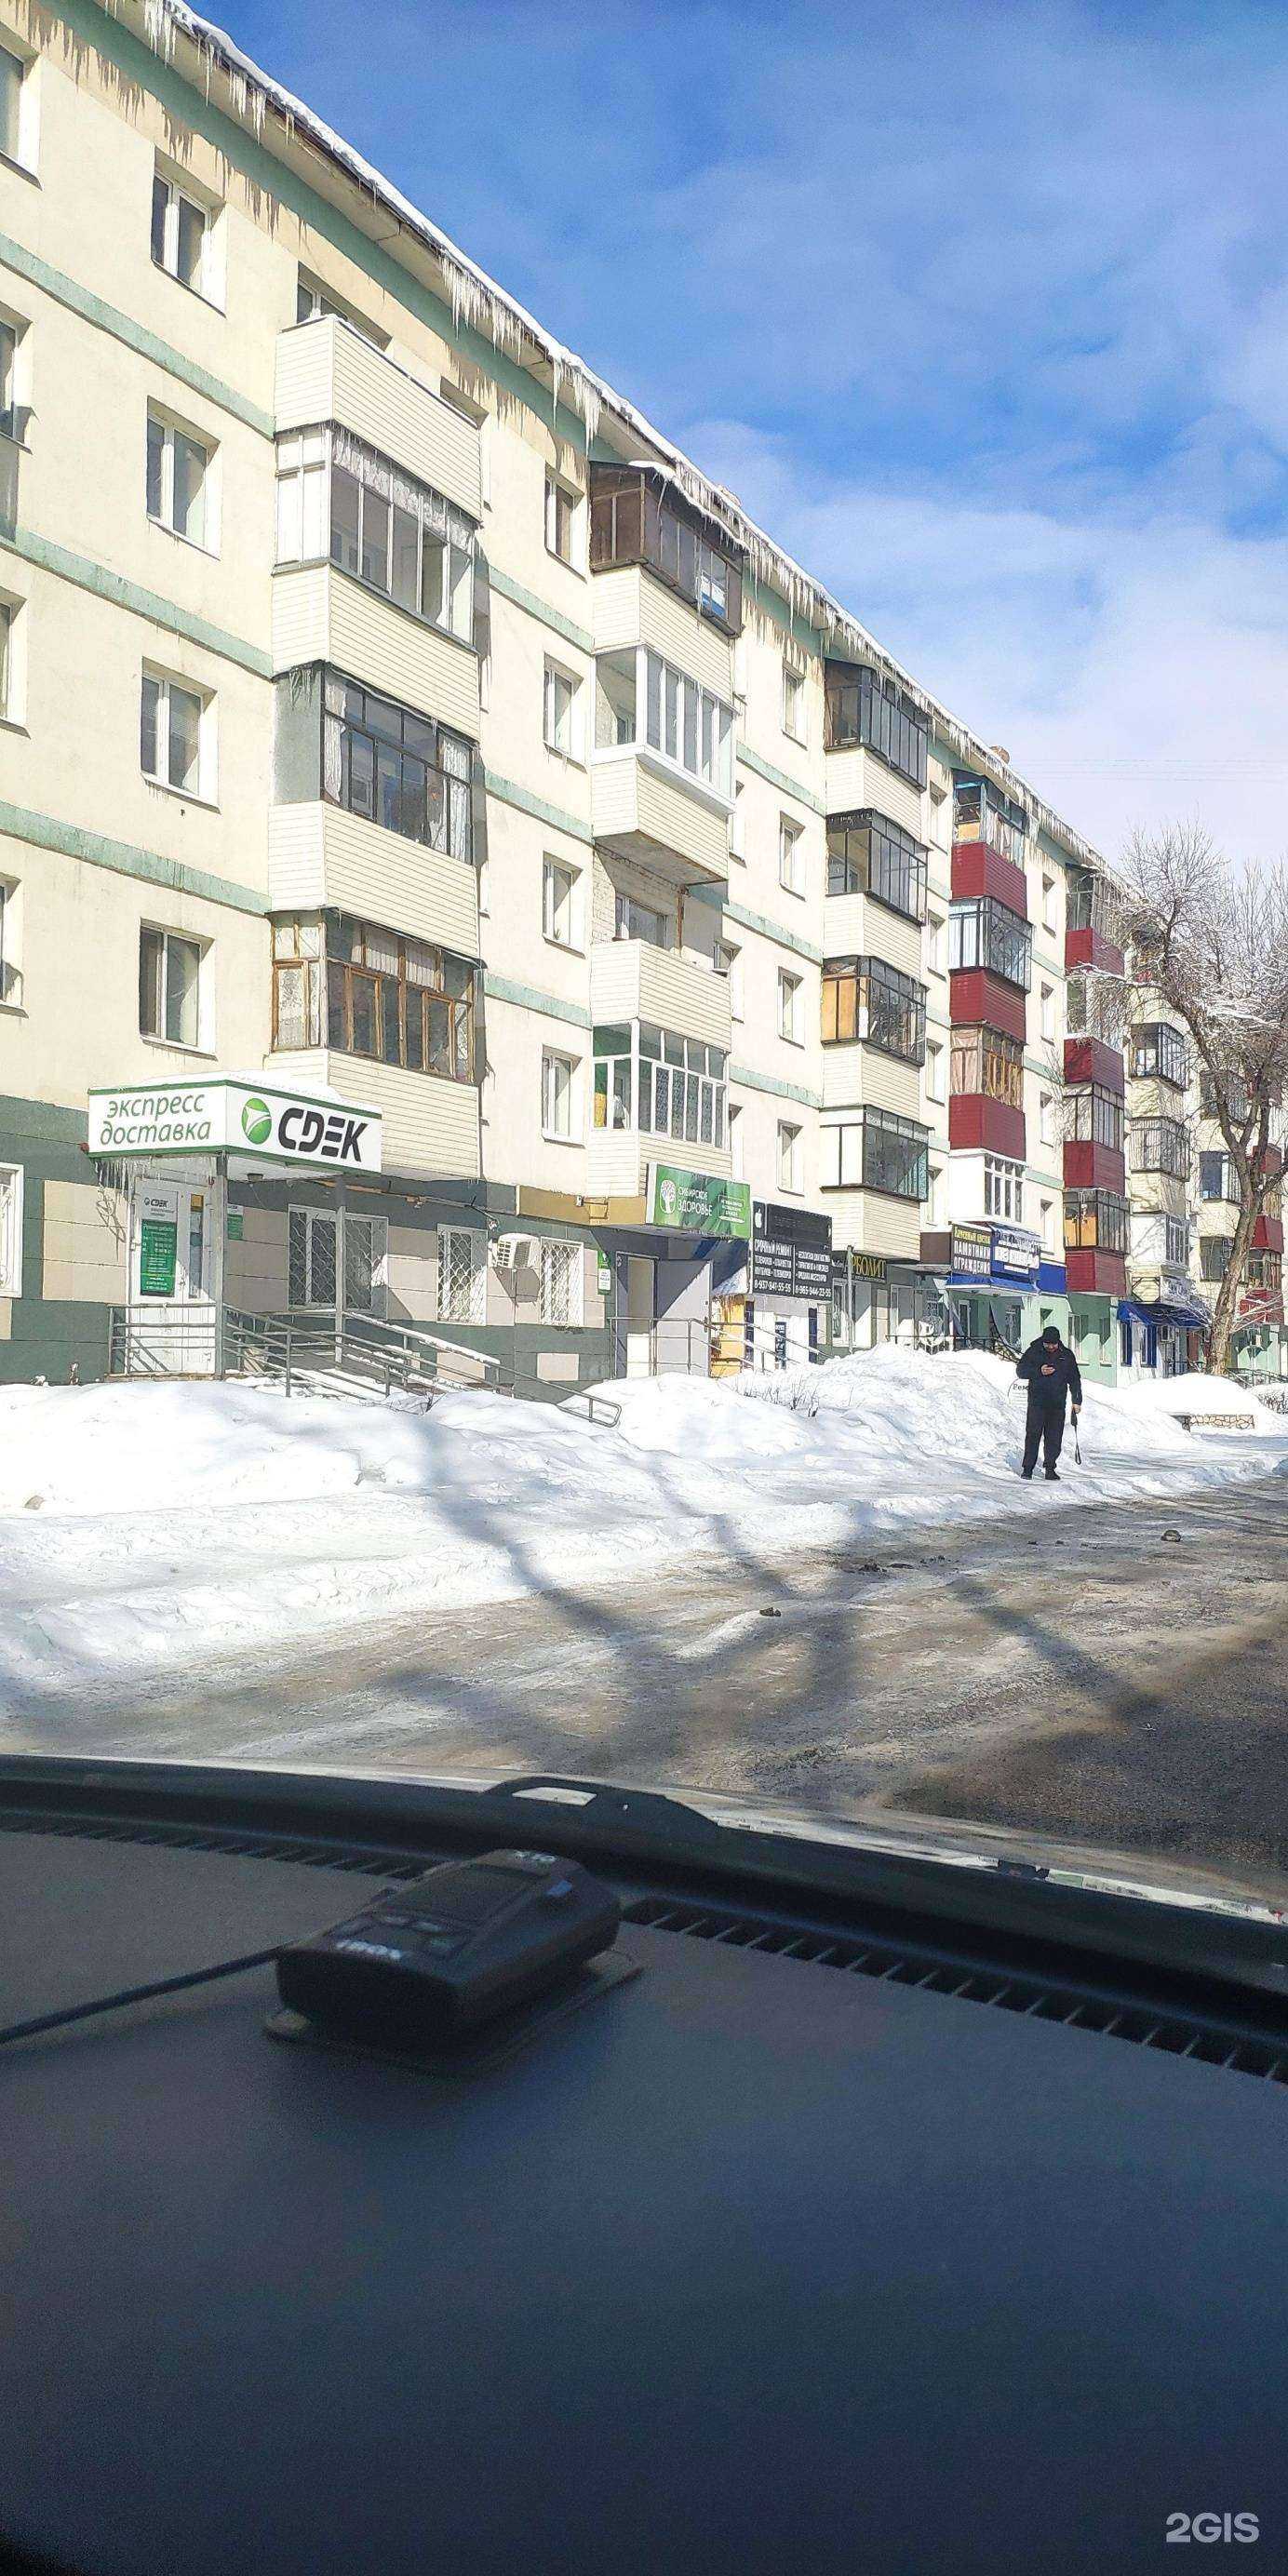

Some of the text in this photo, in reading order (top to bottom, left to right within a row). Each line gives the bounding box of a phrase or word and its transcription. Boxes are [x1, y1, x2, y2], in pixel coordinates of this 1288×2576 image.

[107, 1094, 205, 1121] экспресс
[100, 1120, 211, 1146] доставка
[278, 1107, 369, 1162] CDEK
[678, 1199, 713, 1216] ЗДОРОВЬЕ
[954, 1240, 991, 1260] ПАМЯТНИКИ
